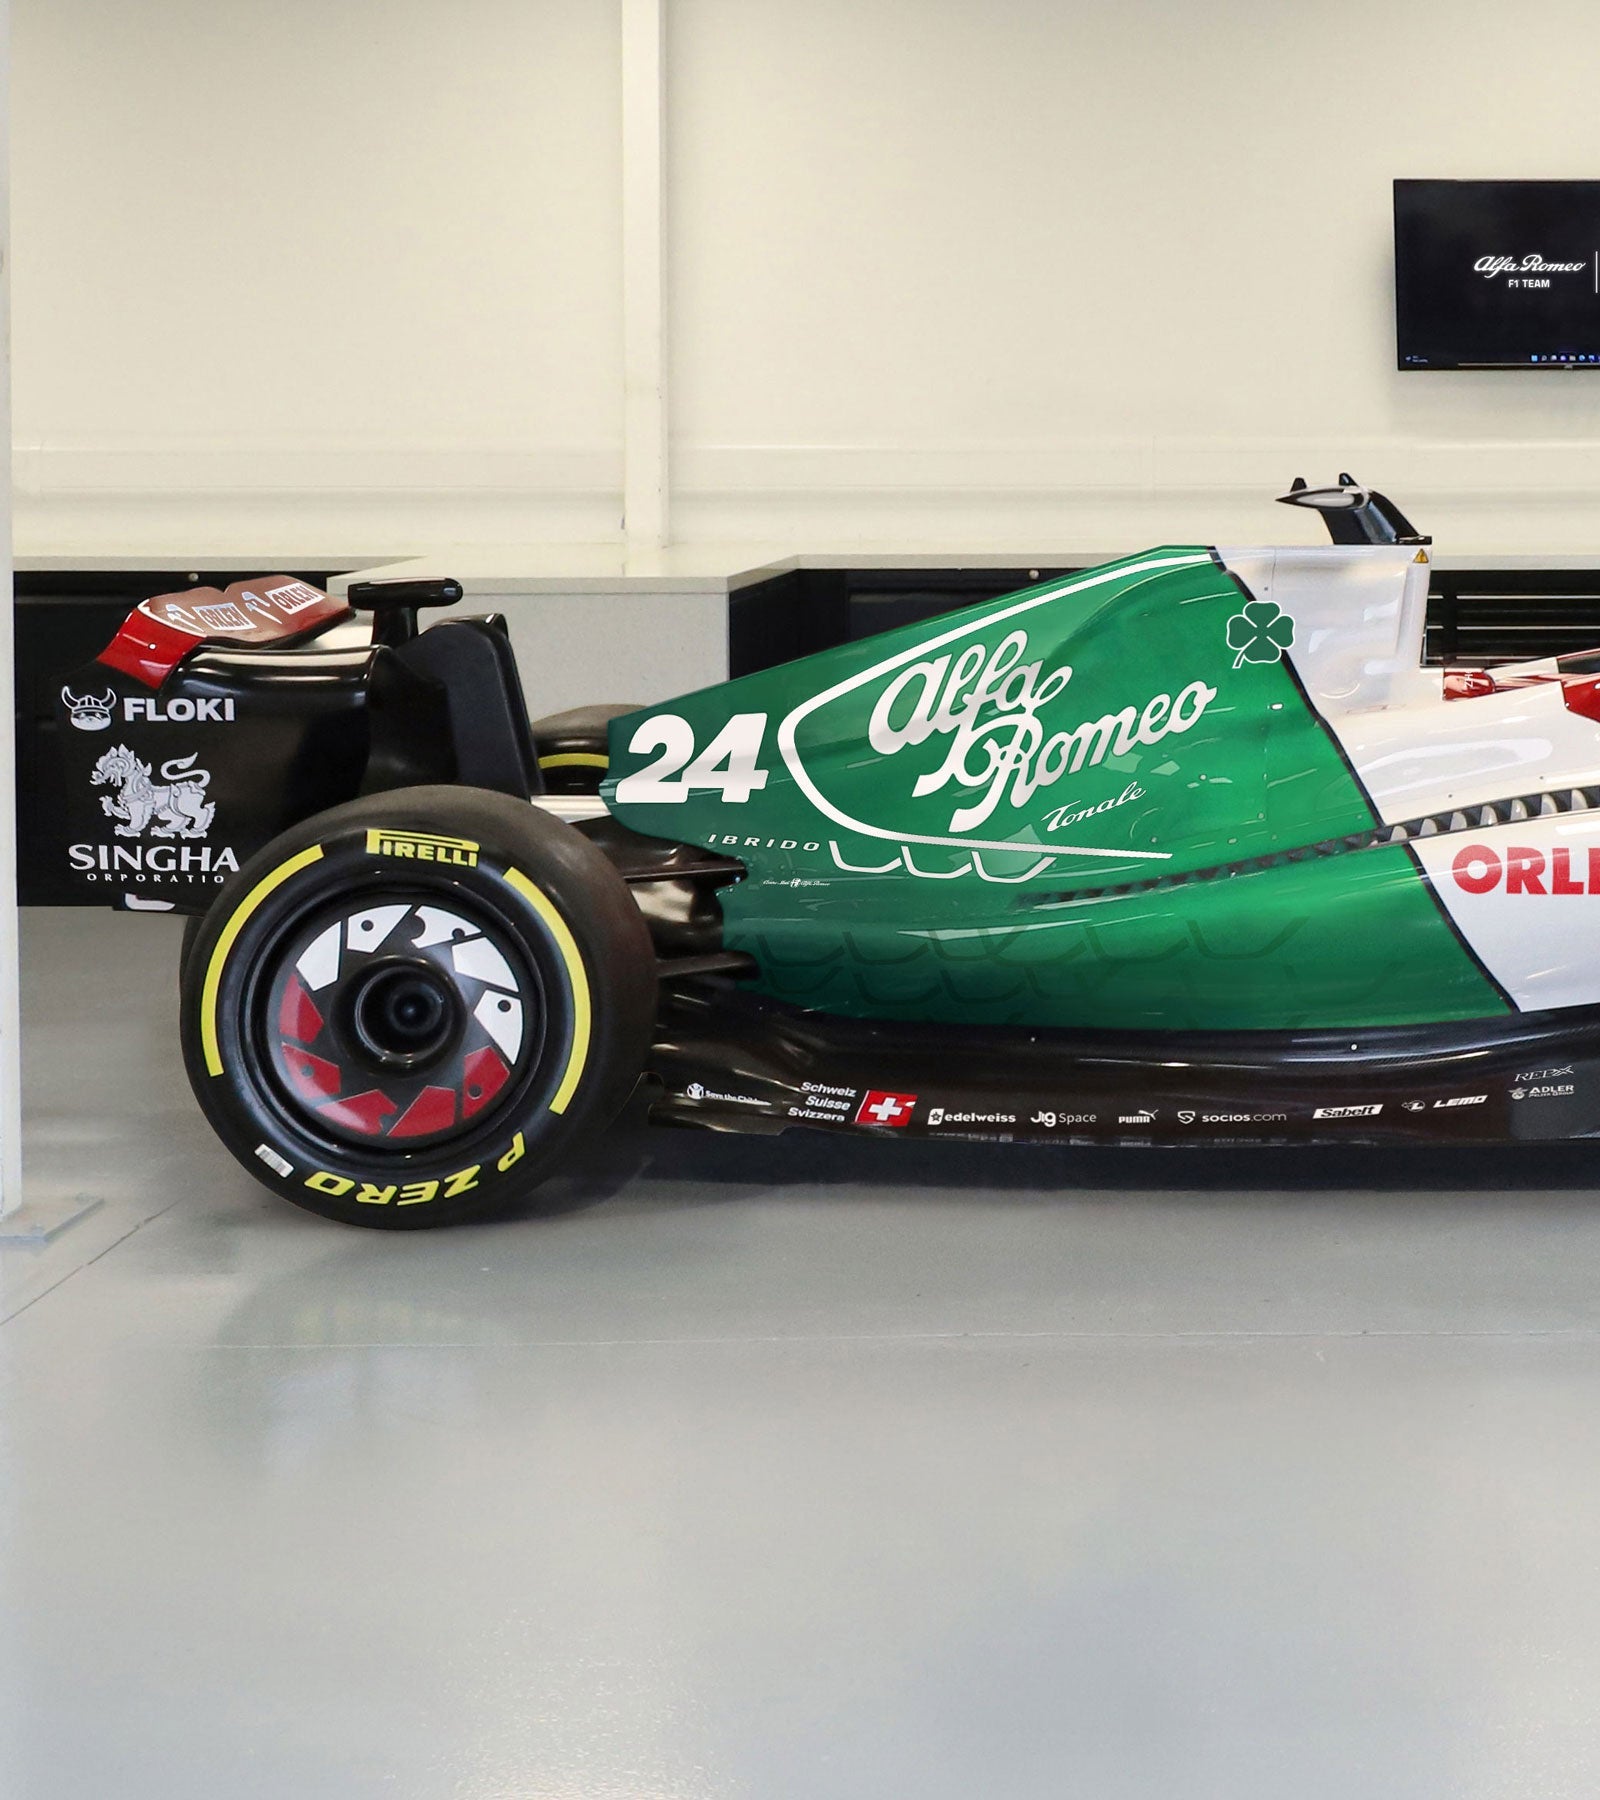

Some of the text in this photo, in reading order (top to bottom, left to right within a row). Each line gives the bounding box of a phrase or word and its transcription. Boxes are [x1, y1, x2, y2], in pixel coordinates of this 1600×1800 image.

[1473, 254, 1586, 279] Alfa Romeo
[1508, 279, 1550, 288] F1 TEAM
[124, 698, 235, 722] FLOKI
[868, 630, 1073, 798] Alfa
[615, 713, 770, 804] 24
[948, 681, 1218, 833] Romeo
[1041, 781, 1147, 832] Tonale
[366, 829, 480, 868] PIRELLI
[708, 834, 820, 851] IBRIDO
[68, 844, 240, 872] SINGHA
[801, 1081, 857, 1098] Schweiz
[1529, 1085, 1575, 1094] ADLER
[805, 1095, 851, 1111] Suisse
[1433, 1095, 1488, 1109] LEMO
[787, 1106, 846, 1123] Svizzera
[944, 1112, 1017, 1124] edelweiss
[1118, 1114, 1151, 1124] PUMA
[1201, 1112, 1287, 1123] socios.com
[1320, 1105, 1375, 1118] Sabelt
[304, 1131, 526, 1206] P ZERO
